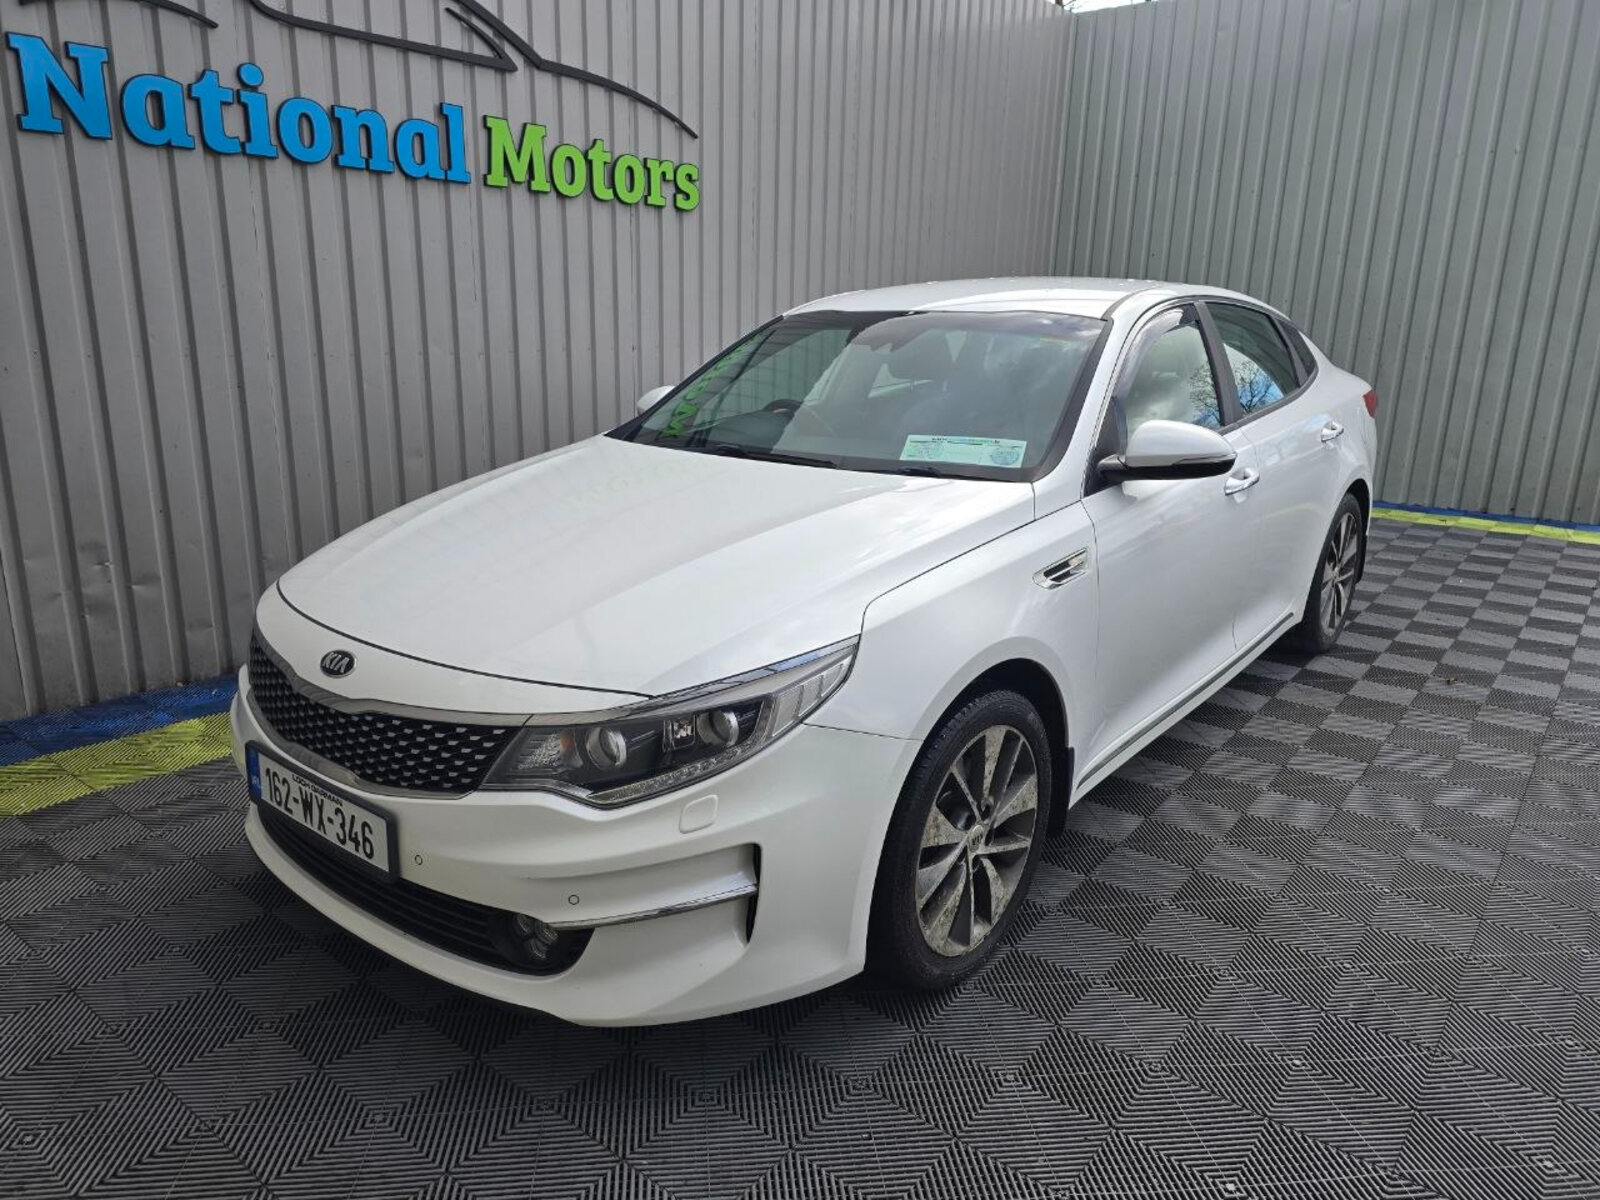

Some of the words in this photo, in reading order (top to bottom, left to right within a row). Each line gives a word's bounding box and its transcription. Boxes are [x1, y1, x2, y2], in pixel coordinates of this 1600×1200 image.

[6, 31, 471, 185] National
[484, 114, 701, 212] Motors
[321, 651, 350, 674] KIA
[265, 767, 375, 860] 162-WX-346
